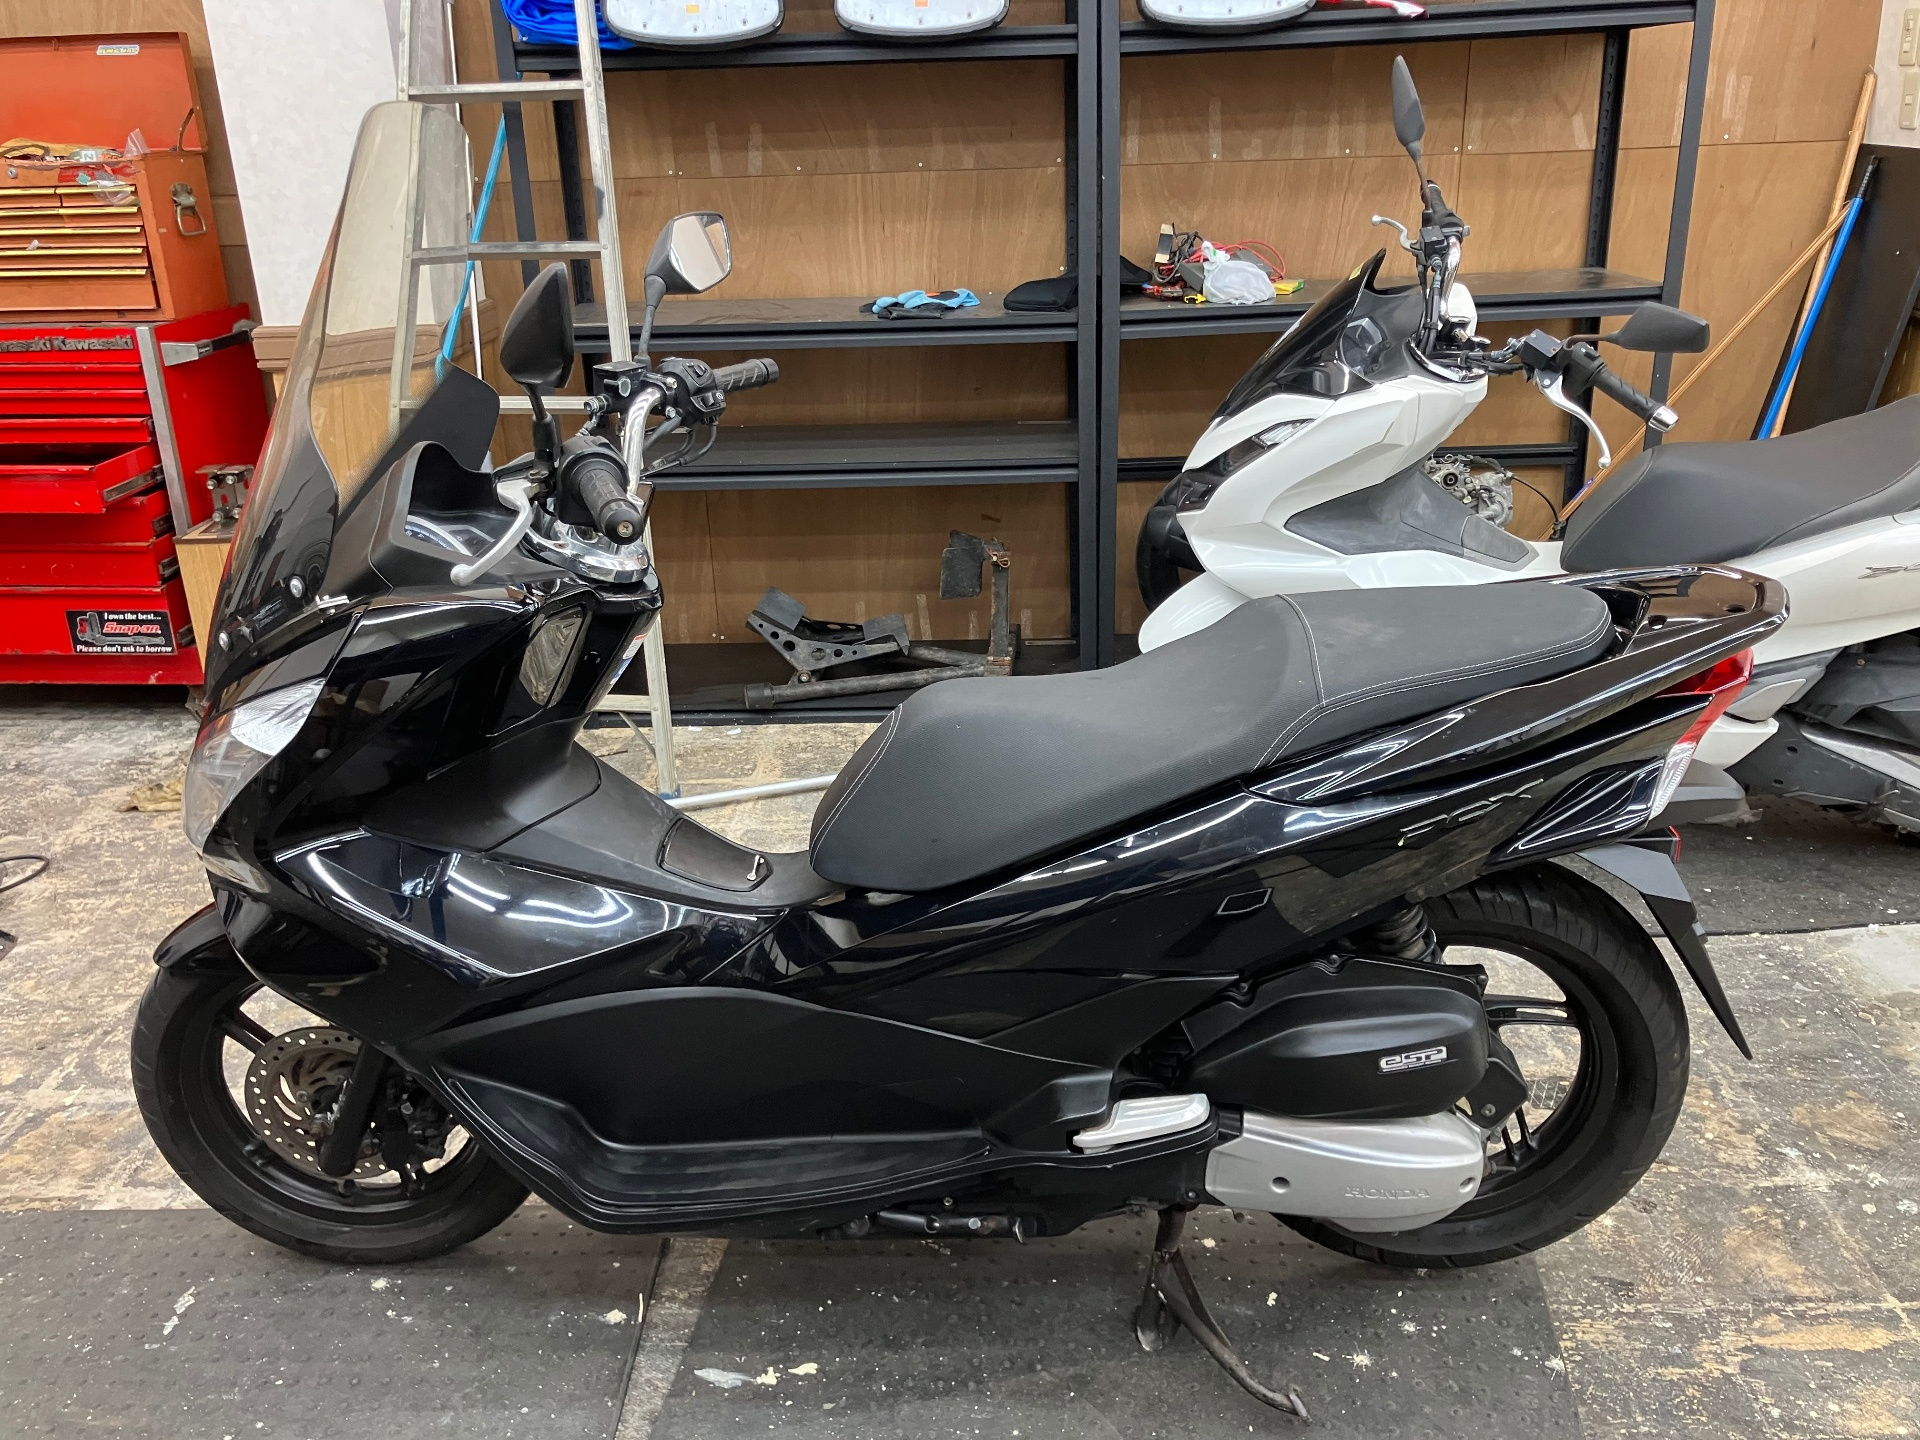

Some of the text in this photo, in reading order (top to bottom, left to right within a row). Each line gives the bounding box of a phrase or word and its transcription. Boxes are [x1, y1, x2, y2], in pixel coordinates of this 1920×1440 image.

[52, 335, 134, 350] Kawasaki
[125, 612, 137, 620] the
[103, 622, 161, 635] Snap-on
[1344, 1187, 1431, 1200] HONDA
